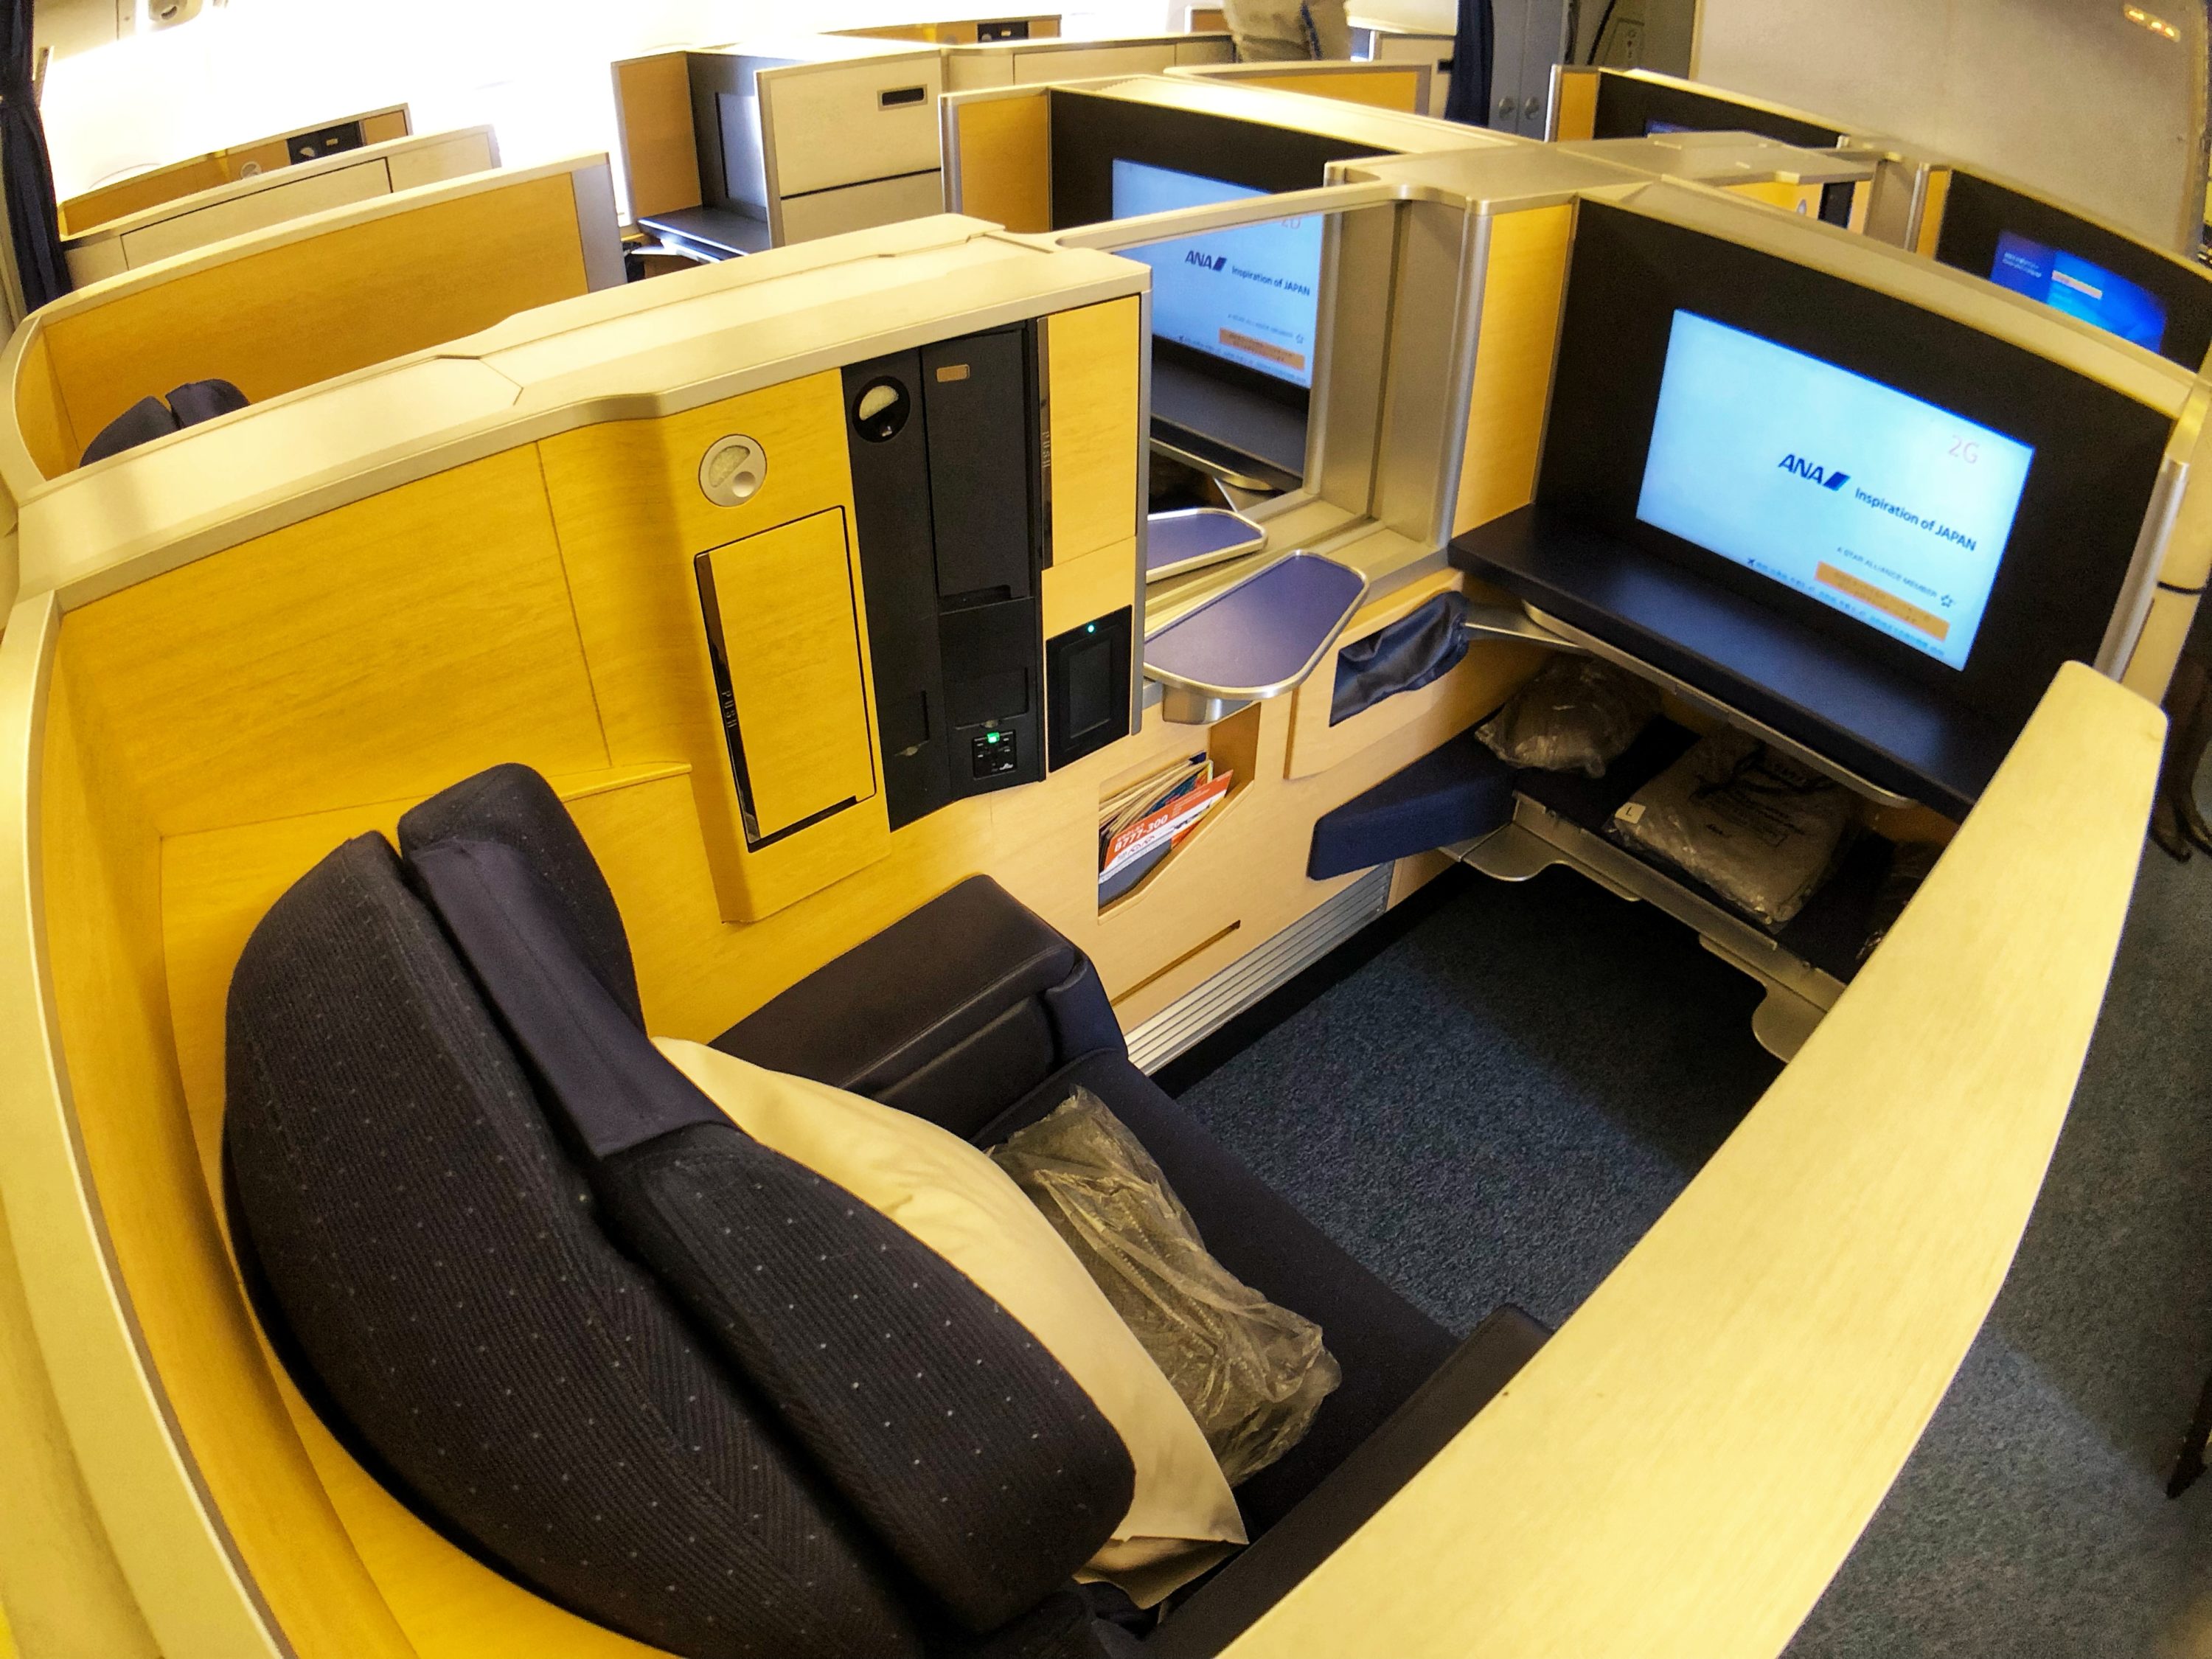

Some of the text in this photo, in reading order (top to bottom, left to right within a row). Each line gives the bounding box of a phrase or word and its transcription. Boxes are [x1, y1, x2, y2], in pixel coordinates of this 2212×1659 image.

[1184, 251, 1211, 269] ANA
[1231, 265, 1310, 296] Inspiration of JAPAN
[1949, 434, 1980, 464] 2G
[1778, 453, 1823, 484] ANA
[1855, 487, 1977, 552] Inspiration of JAPAN
[722, 690, 737, 728] PUSH
[1114, 814, 1169, 853] B777-300
